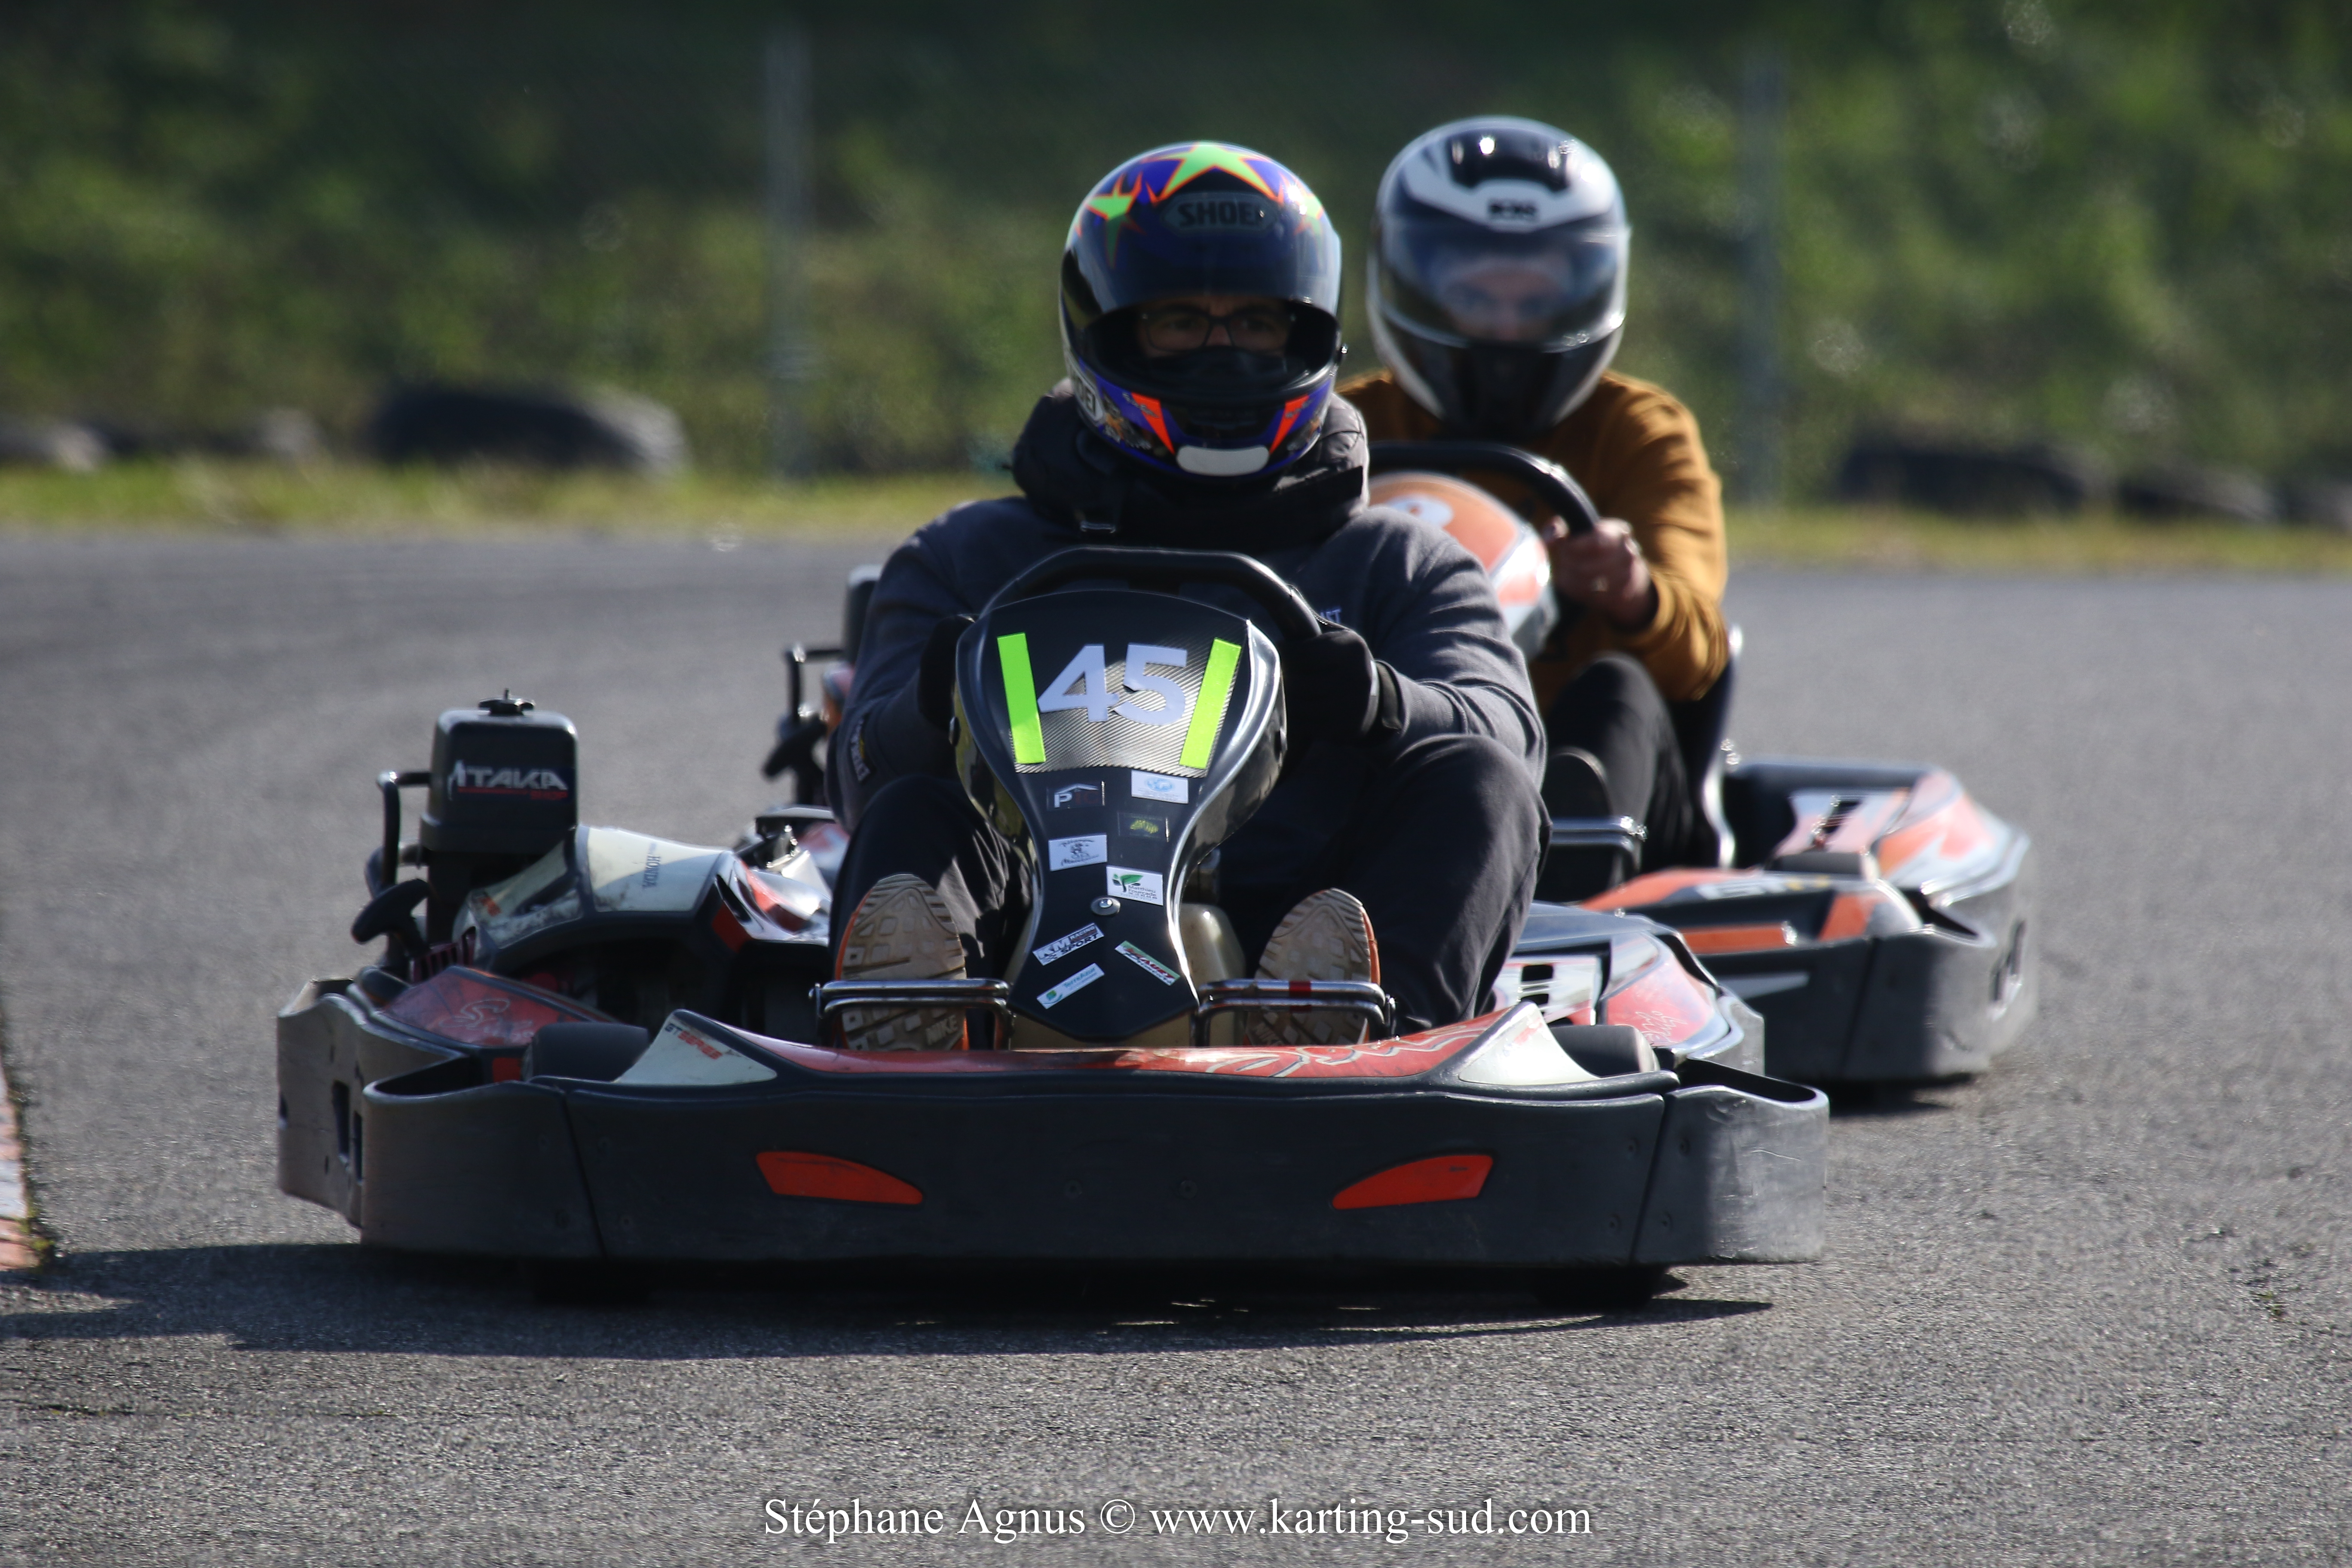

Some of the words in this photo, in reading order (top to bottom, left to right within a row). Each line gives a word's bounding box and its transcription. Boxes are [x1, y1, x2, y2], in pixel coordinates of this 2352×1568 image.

[1038, 643, 1187, 726] 45
[642, 855, 661, 888] HONDA
[1128, 885, 1156, 893] Matthieu
[1061, 933, 1098, 954] SPORT
[925, 1014, 958, 1045] NIKE
